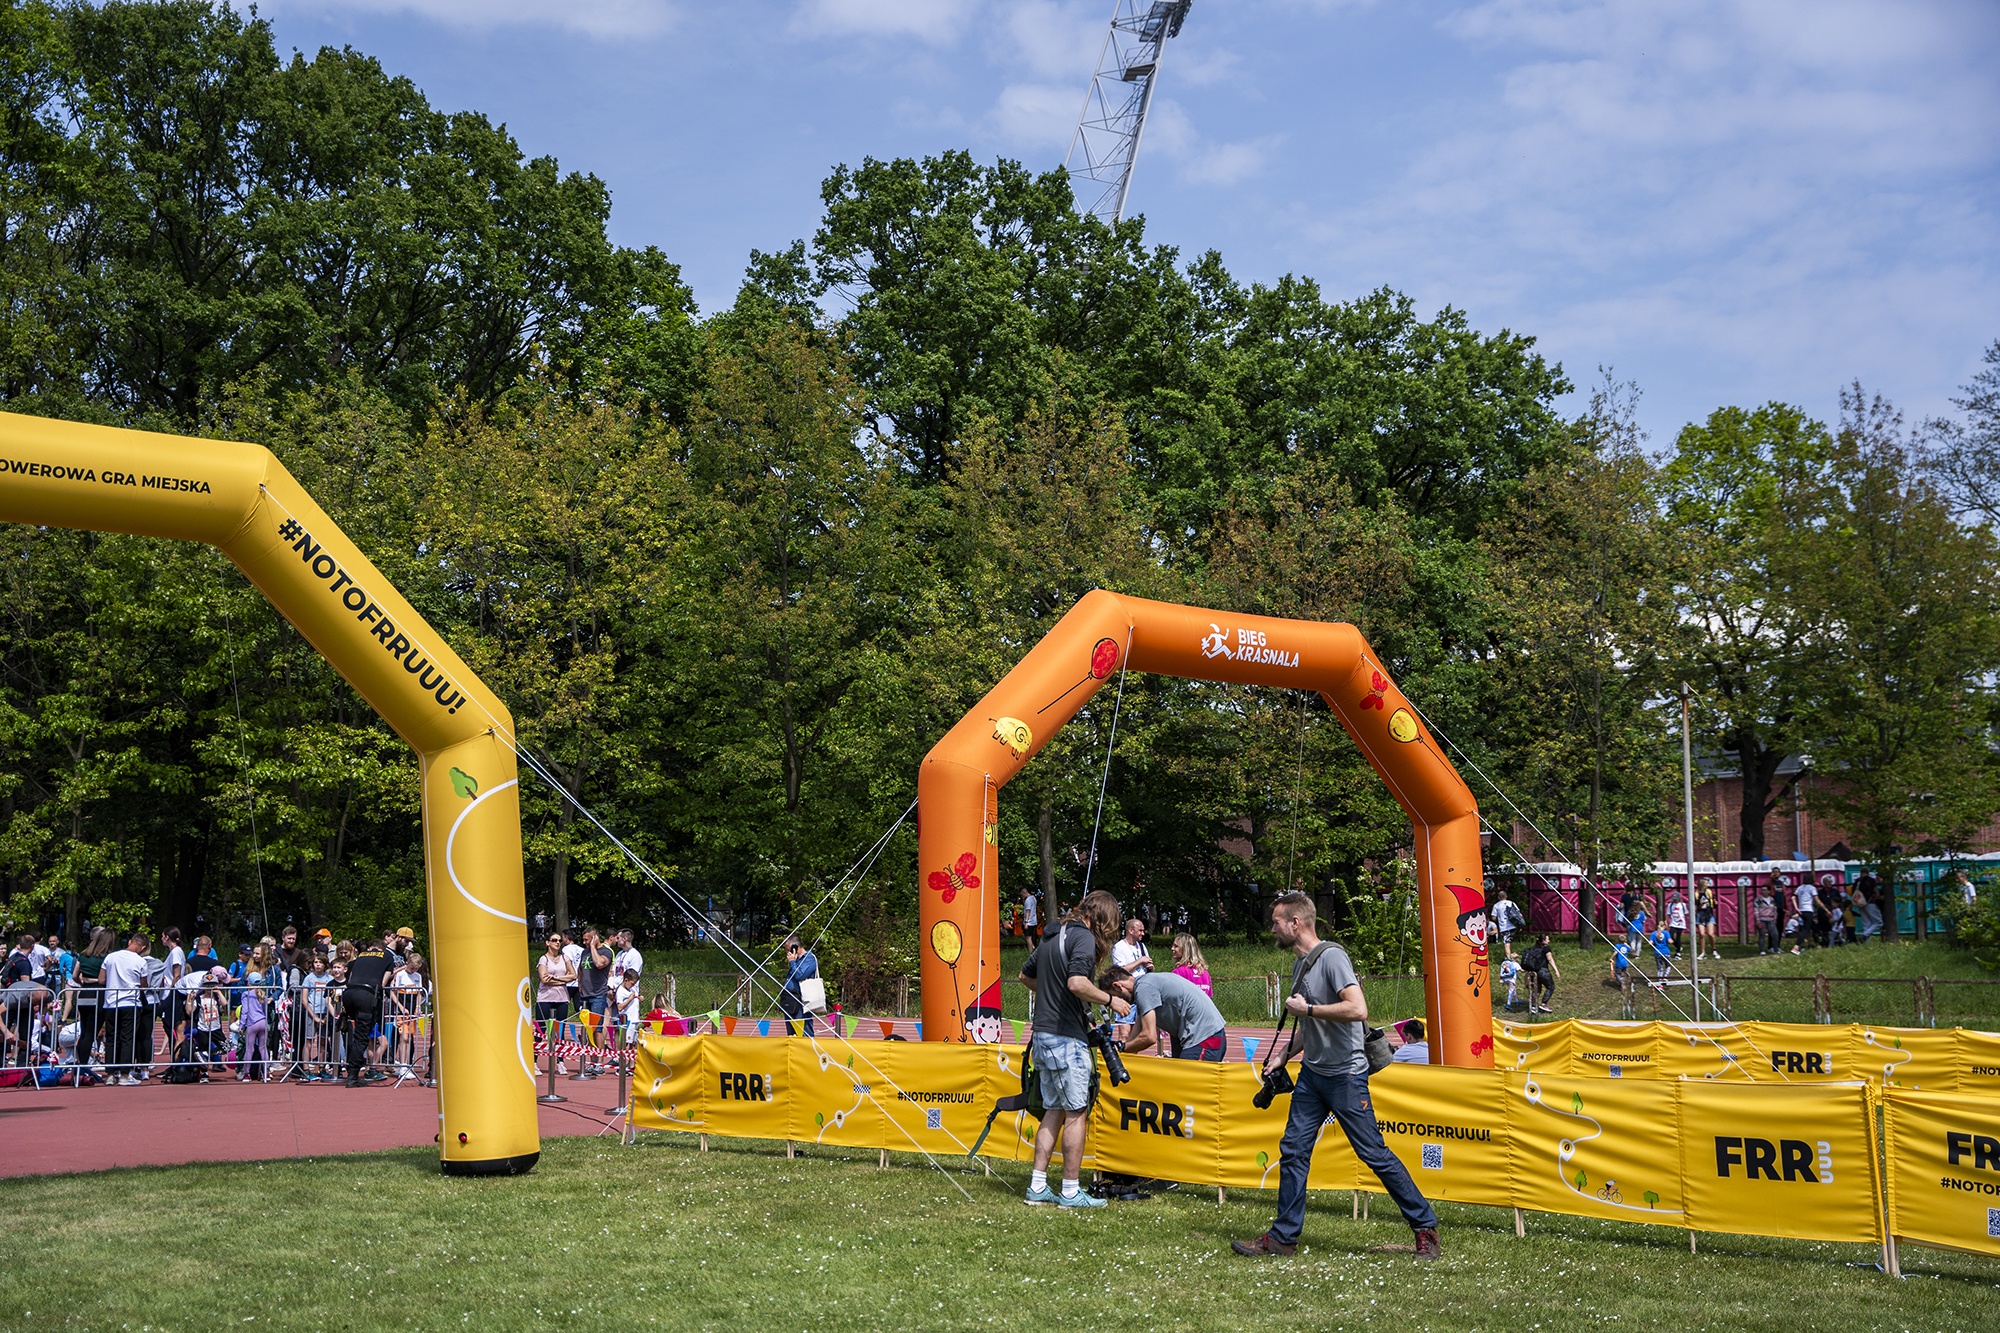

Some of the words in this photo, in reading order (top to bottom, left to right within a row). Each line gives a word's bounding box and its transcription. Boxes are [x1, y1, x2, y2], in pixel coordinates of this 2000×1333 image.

[101, 470, 137, 487] GRA
[141, 474, 212, 494] MIEJSKA
[277, 517, 467, 715] #NOTOFRRUUU!
[1237, 628, 1267, 647] BIEG
[1235, 644, 1299, 668] KRASNALA
[1581, 1052, 1650, 1062] #NOTOFRRUUU!
[897, 1090, 975, 1104] #NOTOFRRUUU!
[1376, 1119, 1491, 1142] #NOTOFRRUUU!
